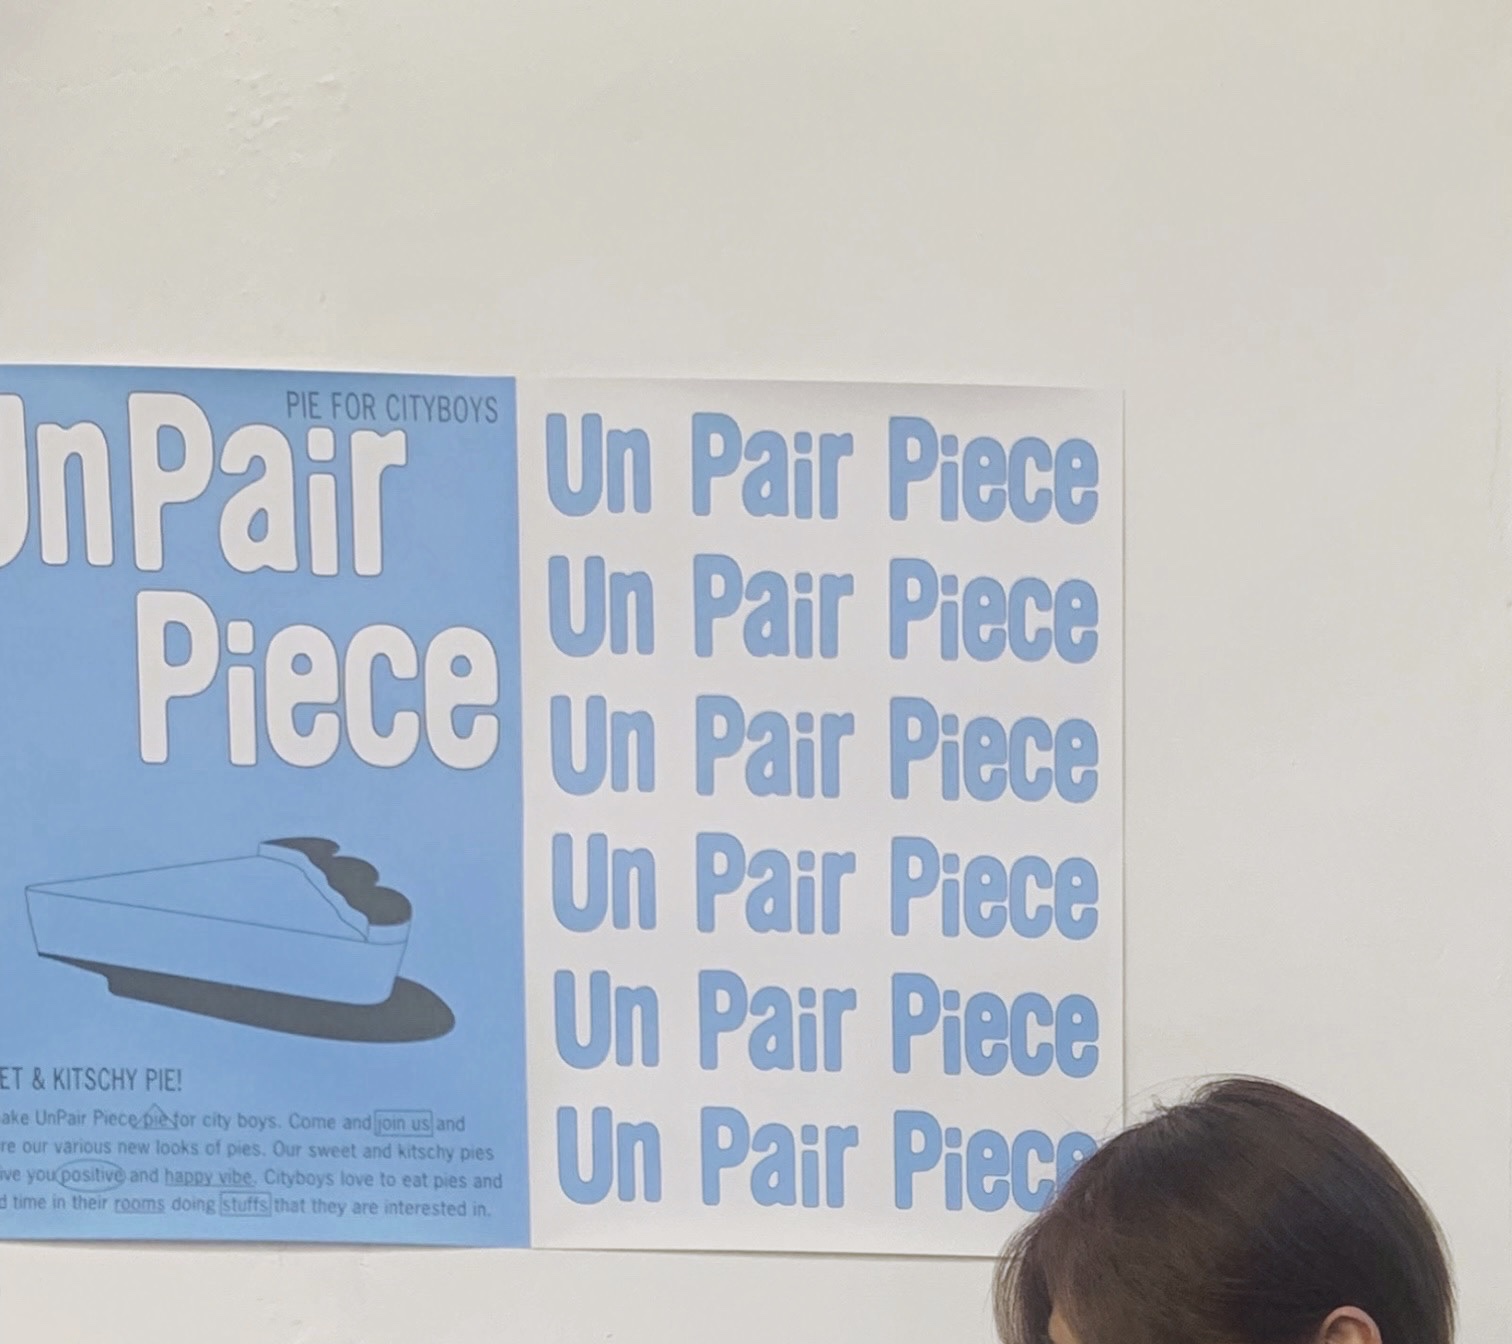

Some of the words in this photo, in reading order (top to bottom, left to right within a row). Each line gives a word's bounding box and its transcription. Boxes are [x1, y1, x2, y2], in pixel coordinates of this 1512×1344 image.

[286, 390, 321, 420] PIE
[332, 393, 376, 421] FOR
[386, 396, 499, 424] CITYBOYS
[545, 413, 651, 516] Un
[692, 412, 853, 519] Pair
[888, 416, 1099, 523] Piece
[548, 555, 654, 656] Un
[693, 553, 854, 657] Pair
[889, 557, 1099, 663] Piece
[135, 590, 499, 770] Piece
[550, 694, 656, 795] Un
[695, 694, 855, 799] Pair
[890, 696, 1099, 803] Piece
[551, 832, 656, 932] Un
[696, 832, 856, 935] Pair
[890, 836, 1098, 940] Piece
[553, 969, 660, 1069] Un
[698, 969, 857, 1072] Pair
[891, 971, 1099, 1078] Piece
[31, 1066, 46, 1091] &
[53, 1067, 138, 1092] KITSCHY
[145, 1068, 183, 1093] PIE!
[35, 1109, 87, 1128] UnPair
[93, 1110, 138, 1129] Piece
[143, 1111, 169, 1132] pie
[175, 1112, 196, 1129] for
[202, 1112, 232, 1133] city
[237, 1113, 282, 1134] boys.
[288, 1112, 336, 1131] Come
[342, 1114, 372, 1131] and
[377, 1114, 406, 1136] join
[411, 1117, 431, 1132] us
[436, 1115, 466, 1133] and
[22, 1140, 48, 1155] our
[54, 1138, 112, 1156] various
[118, 1140, 150, 1156] new
[156, 1138, 199, 1157] looks
[205, 1139, 221, 1157] of
[227, 1140, 267, 1159] pies.
[272, 1140, 302, 1159] Our
[308, 1142, 356, 1160] sweet
[363, 1143, 392, 1160] and
[398, 1143, 454, 1164] kitschy
[460, 1145, 495, 1164] pies
[26, 1169, 56, 1187] you
[61, 1166, 126, 1187] positive
[130, 1167, 159, 1184] and
[165, 1168, 214, 1187] happy
[219, 1169, 257, 1186] vibe.
[264, 1168, 335, 1189] Cityboys
[340, 1169, 374, 1187] love
[379, 1171, 396, 1187] to
[402, 1172, 429, 1188] eat
[434, 1172, 467, 1191] pies
[473, 1173, 503, 1190] and
[556, 1105, 662, 1205] Un
[700, 1106, 859, 1208] Pair
[13, 1194, 46, 1210] time
[52, 1194, 66, 1210] in
[72, 1194, 108, 1211] their
[114, 1197, 165, 1212] rooms
[171, 1195, 216, 1215] doing
[222, 1195, 270, 1212] stuffs
[274, 1197, 306, 1213] that
[311, 1197, 346, 1217] they
[351, 1201, 378, 1216] are
[384, 1200, 467, 1217] interested
[472, 1200, 491, 1217] in.
